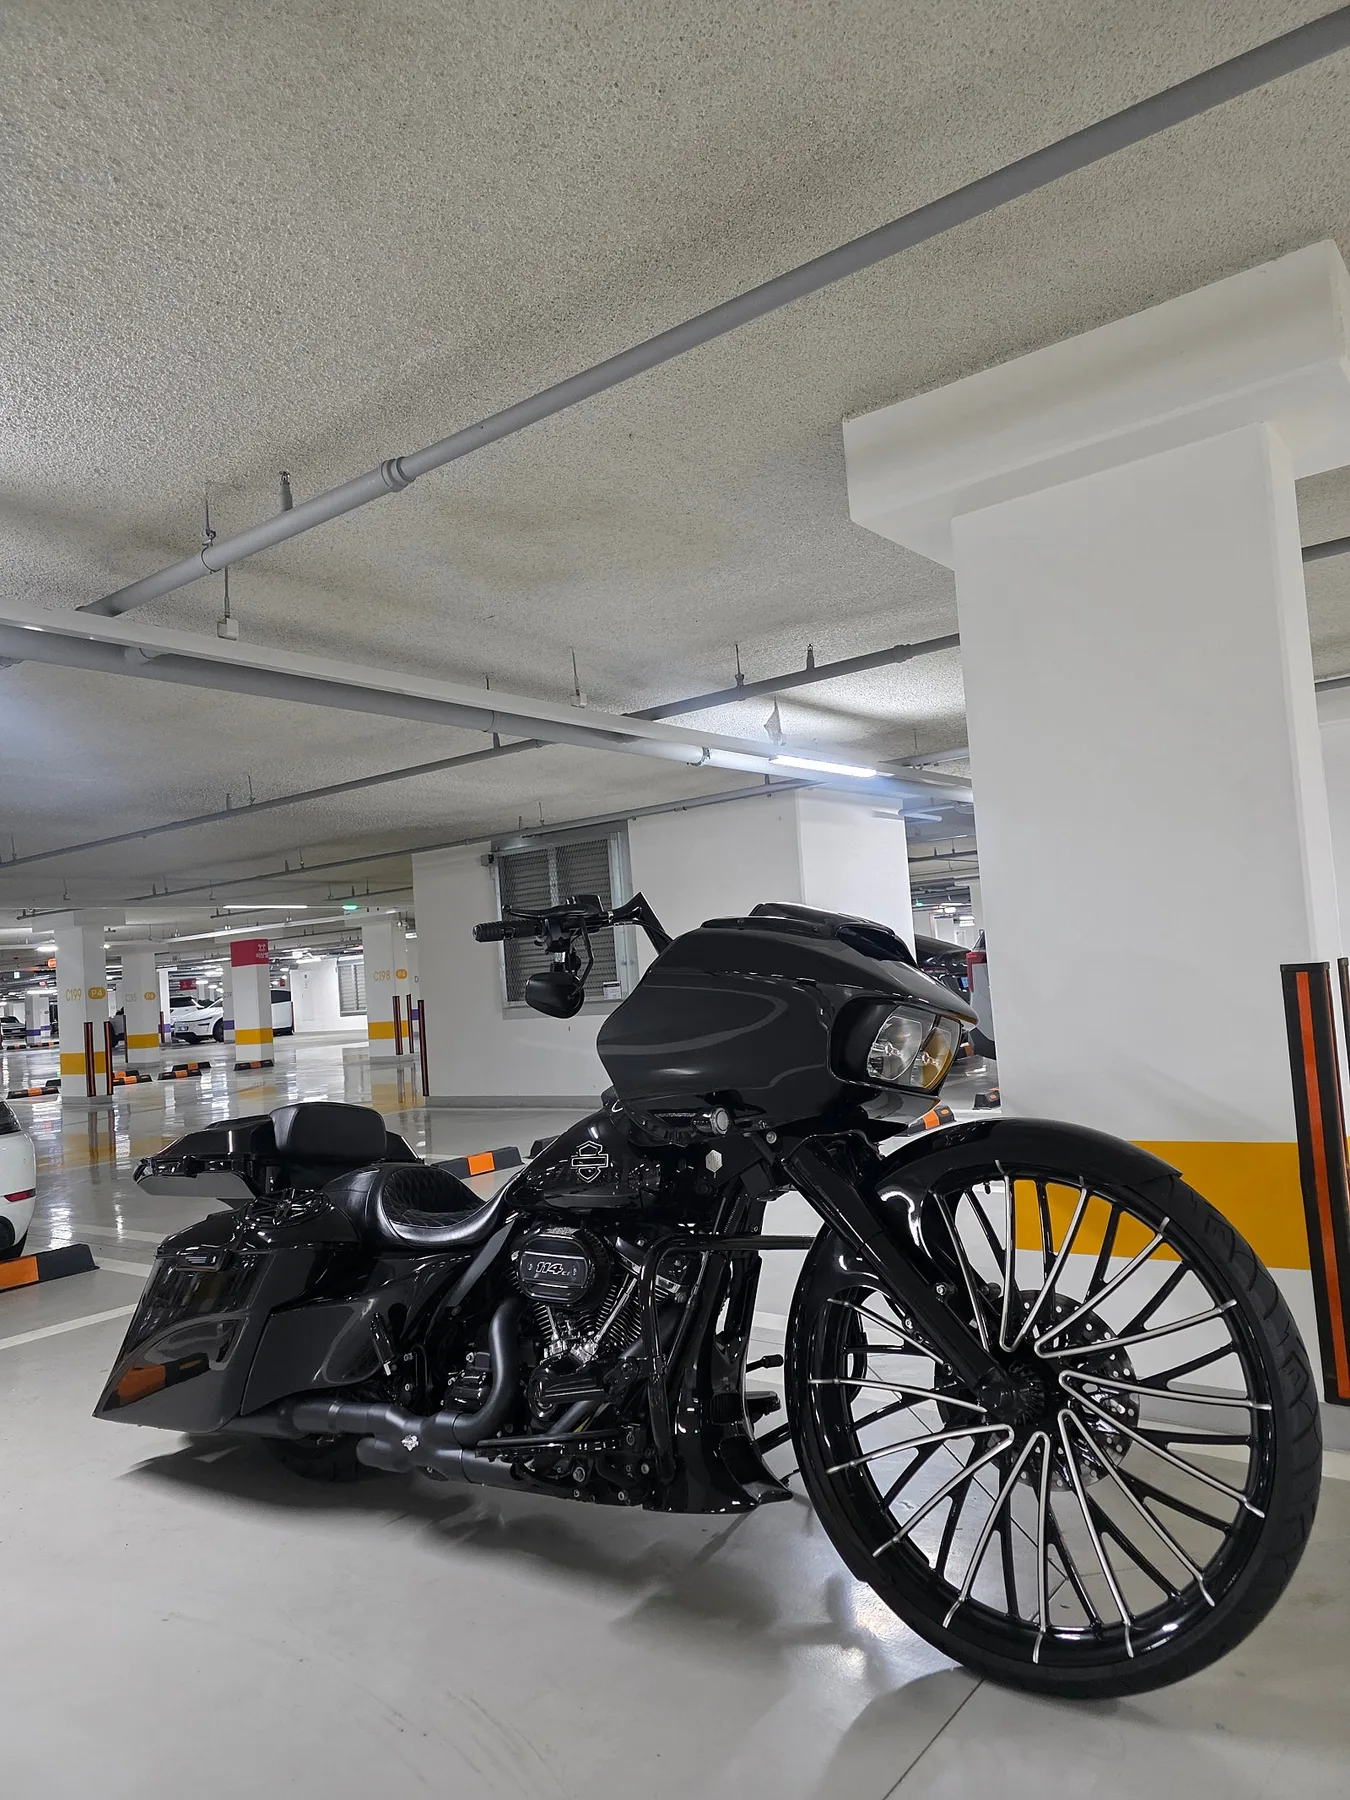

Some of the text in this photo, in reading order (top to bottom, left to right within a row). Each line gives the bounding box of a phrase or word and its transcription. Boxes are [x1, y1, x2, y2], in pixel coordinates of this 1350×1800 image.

[373, 970, 391, 981] C198
[65, 988, 82, 1002] C199
[91, 989, 103, 997] P4
[536, 1261, 564, 1275] 114
